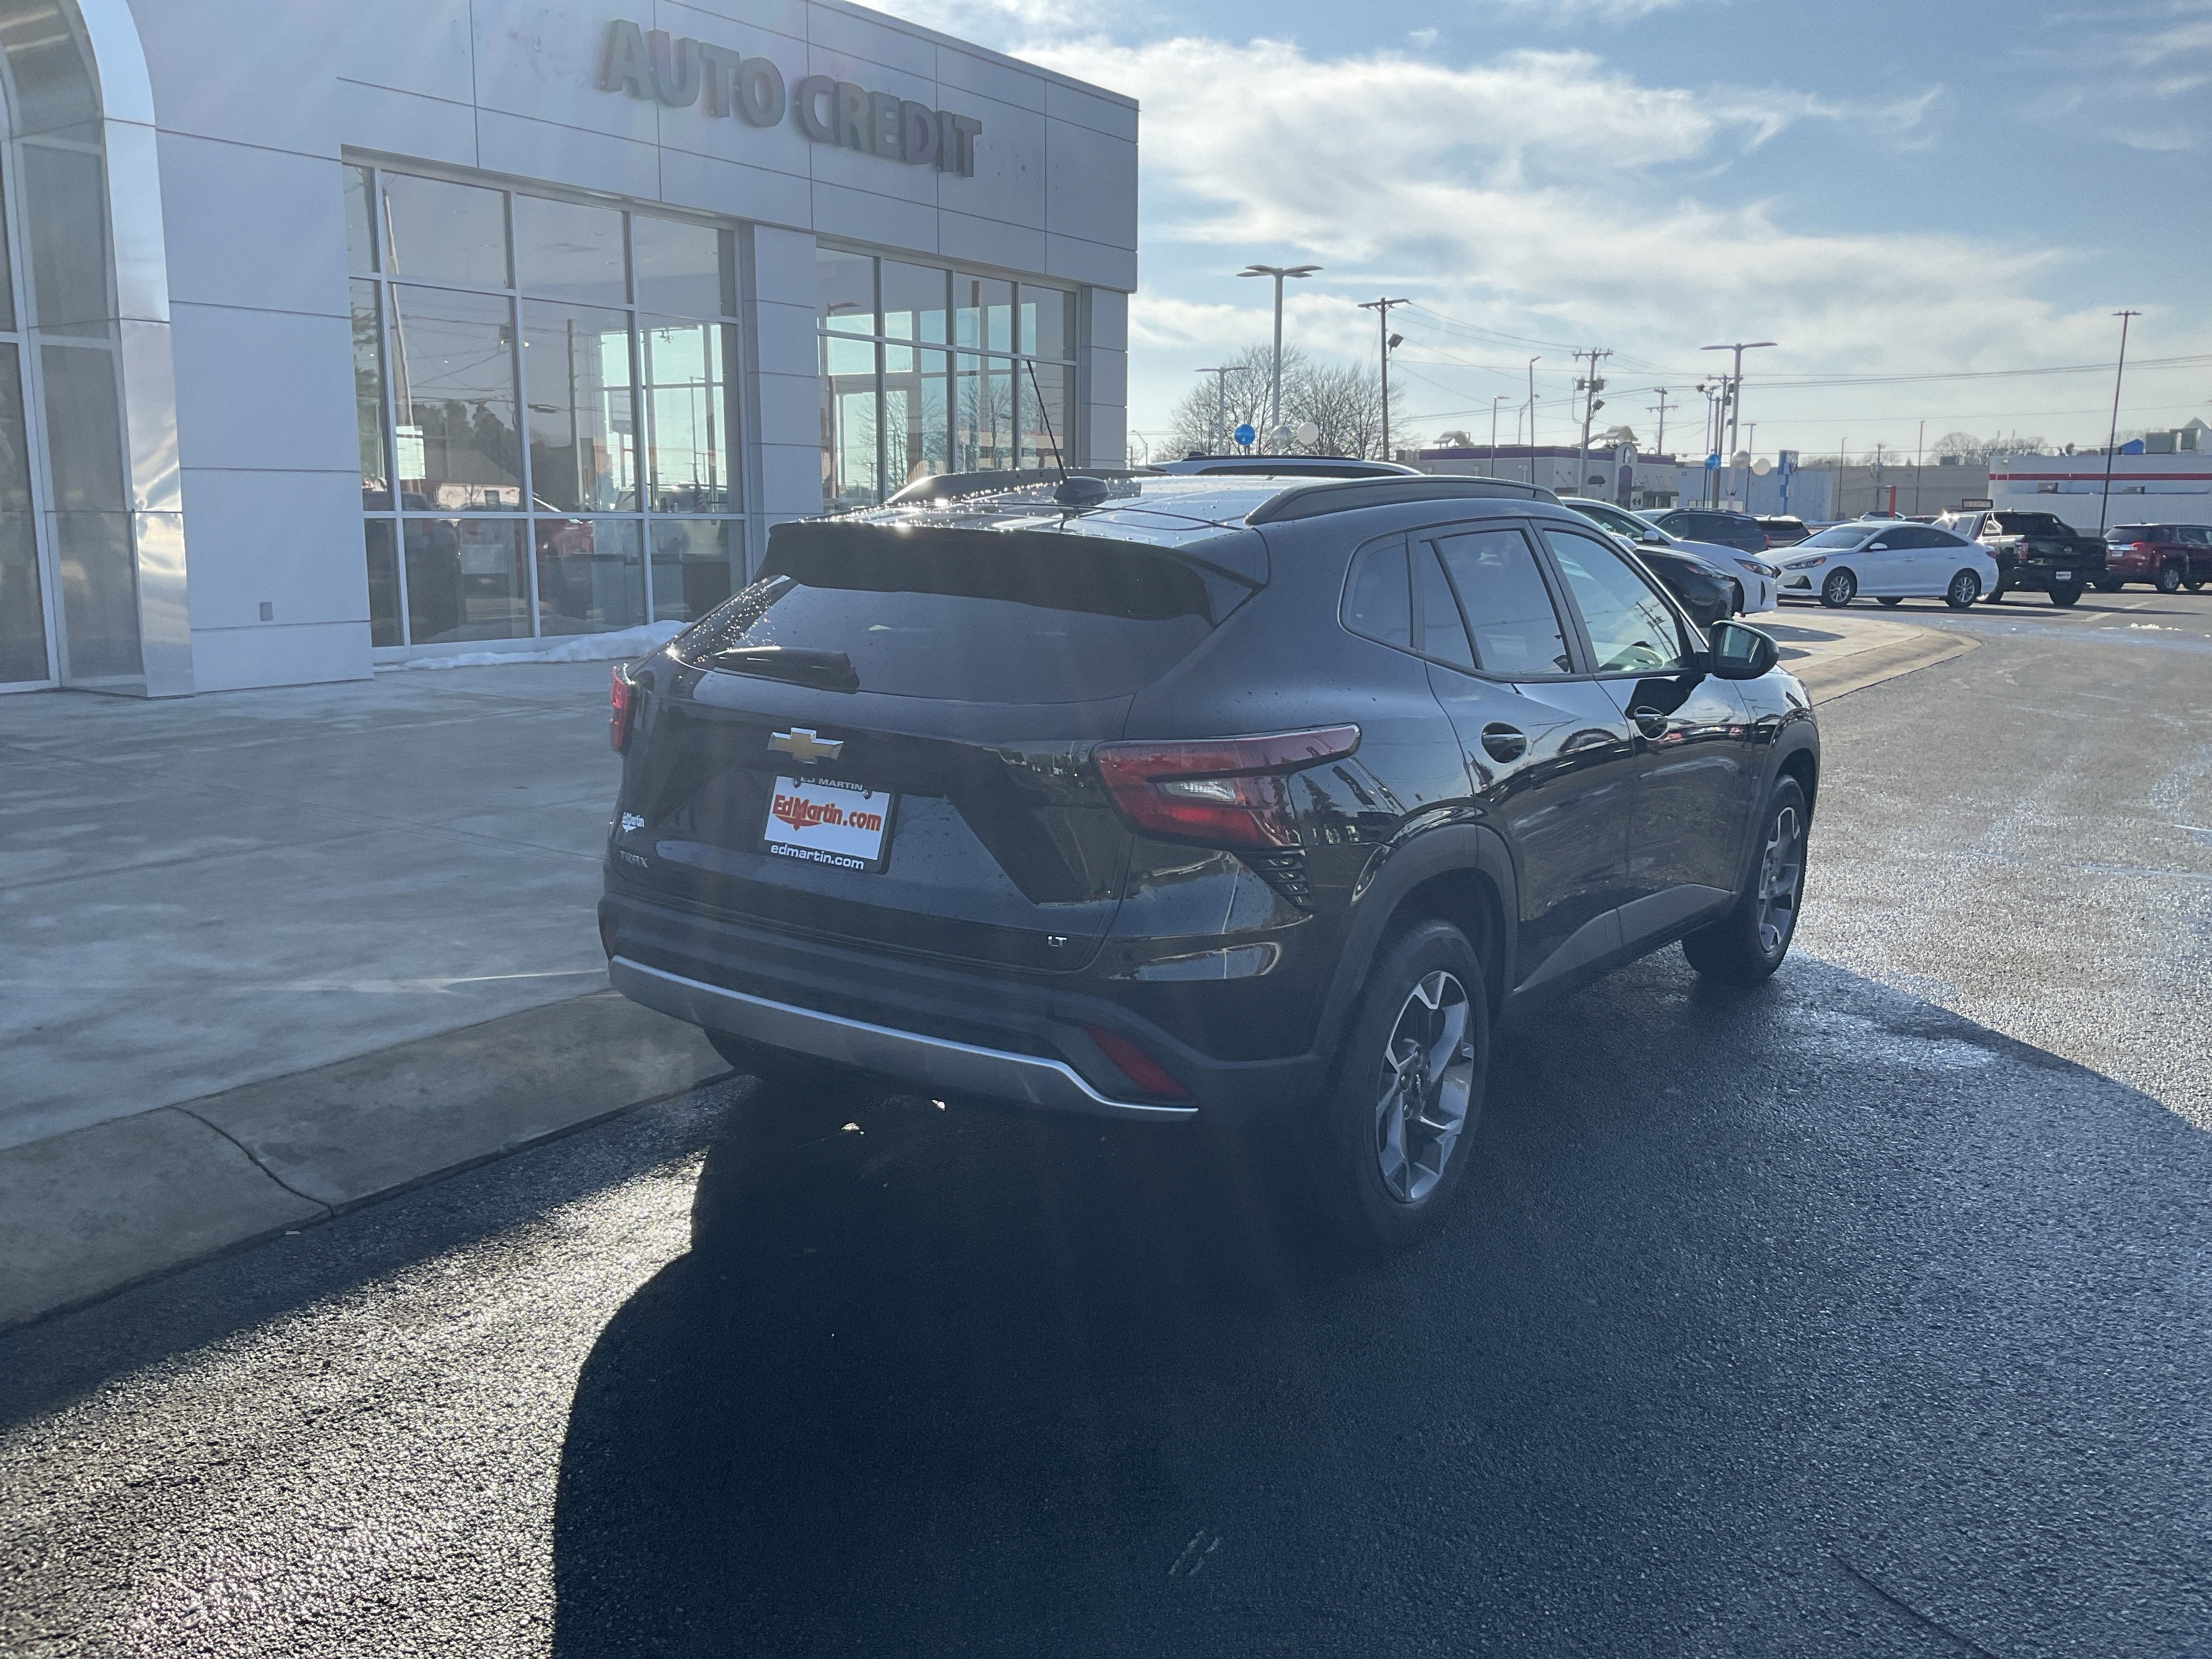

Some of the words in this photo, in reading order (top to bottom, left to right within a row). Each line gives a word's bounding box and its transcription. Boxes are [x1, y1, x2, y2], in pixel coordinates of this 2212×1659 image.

[602, 19, 786, 127] AUTO
[795, 75, 982, 177] CREDIT
[819, 778, 863, 791] MARTIN
[772, 794, 882, 831] EdMartin.com
[771, 844, 864, 870] edmartin.com
[1048, 936, 1066, 947] LT
